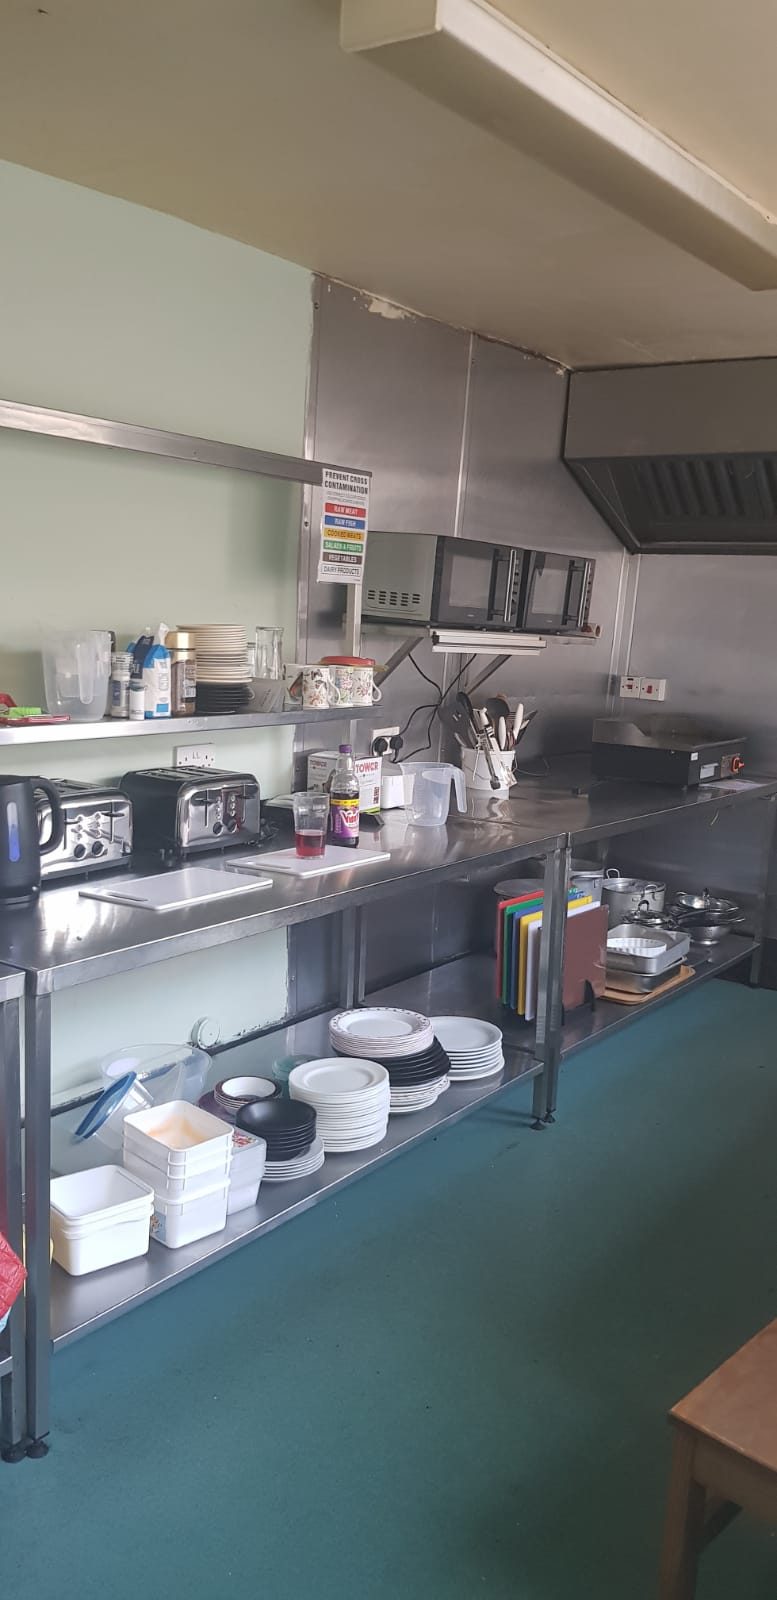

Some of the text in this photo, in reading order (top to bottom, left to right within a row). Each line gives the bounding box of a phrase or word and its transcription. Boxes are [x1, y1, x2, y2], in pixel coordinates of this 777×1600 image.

[325, 471, 368, 485] PREVENT CROSS
[324, 480, 368, 494] CONTAMINATION
[334, 505, 358, 515] RAW MEAT
[327, 529, 361, 540] COOKED MEATS
[328, 554, 357, 563] VEGETABLES
[323, 565, 360, 576] DAIRY PRODUCTS
[355, 762, 379, 773] TOWER
